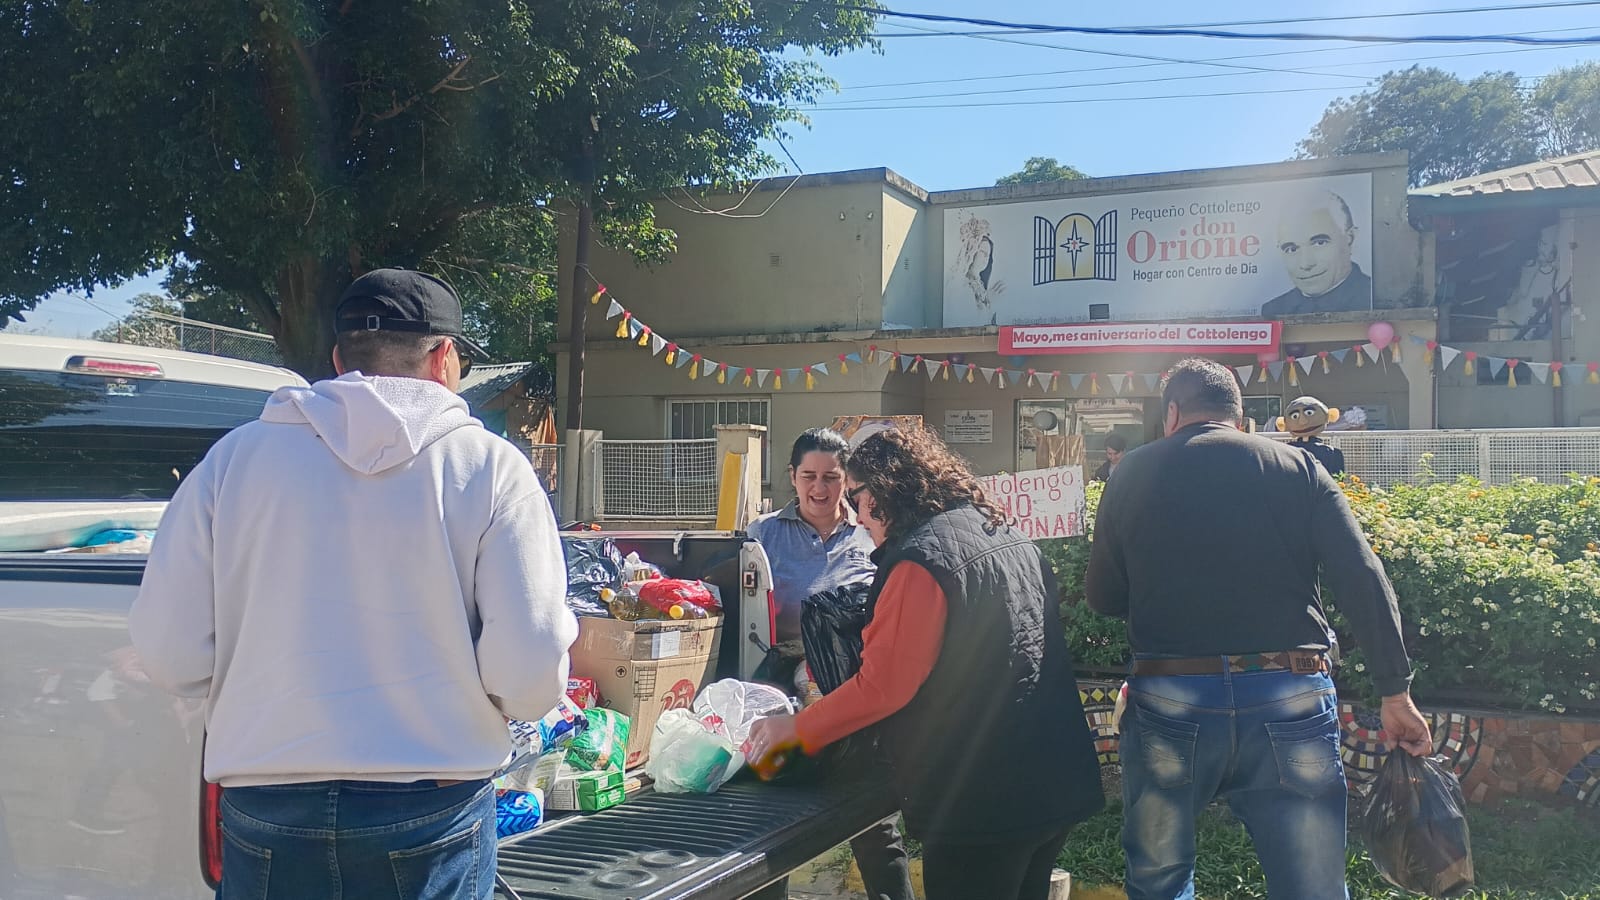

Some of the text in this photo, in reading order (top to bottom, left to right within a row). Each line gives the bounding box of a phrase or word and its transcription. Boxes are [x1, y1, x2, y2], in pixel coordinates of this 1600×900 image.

[1131, 200, 1261, 222] Pequeño Cottolengo
[1192, 216, 1236, 237] don
[1126, 229, 1261, 264] Orione
[1133, 262, 1258, 283] Hogar con Centro de Día
[1080, 328, 1157, 342] aniversario
[1158, 327, 1180, 340] del
[1186, 327, 1268, 341] Cottolengo
